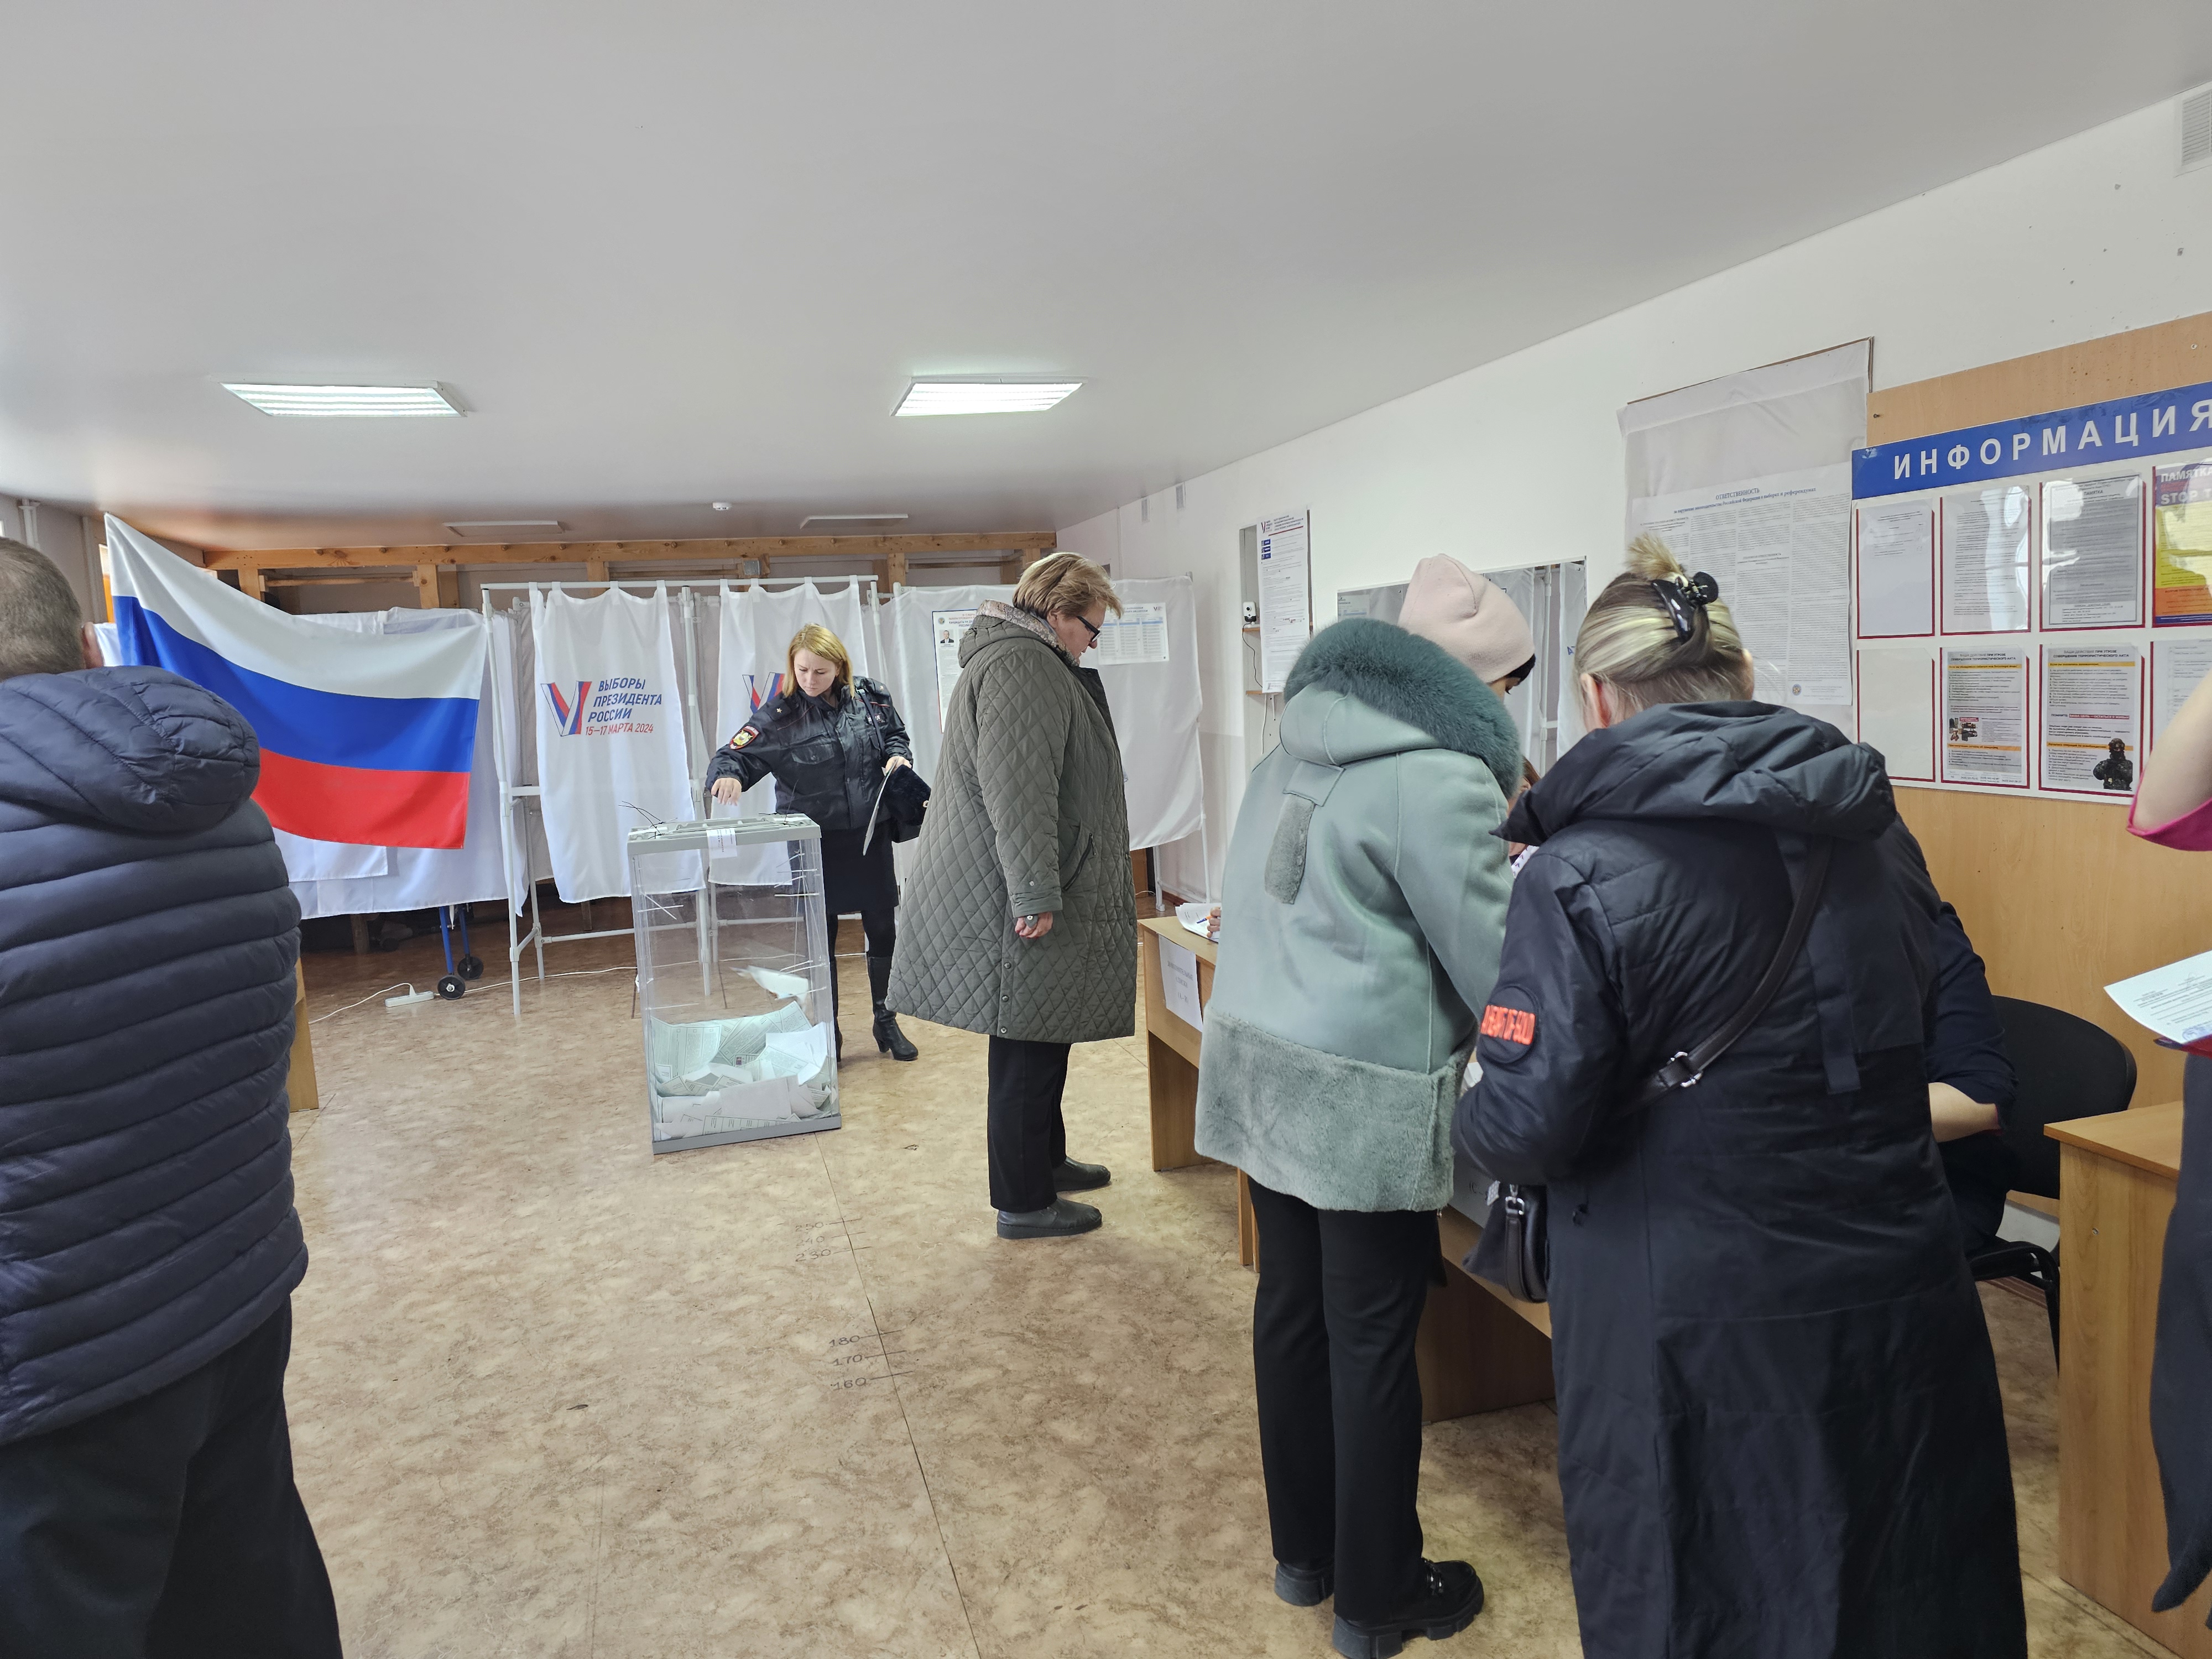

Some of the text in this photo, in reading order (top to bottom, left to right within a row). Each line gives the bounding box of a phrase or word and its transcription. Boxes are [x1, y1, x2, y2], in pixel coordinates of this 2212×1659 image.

[1894, 399, 2212, 479] ИНФОРМАЦИЯ
[1715, 488, 1760, 500] ОТВЕТСТВЕННОСТЬ
[1784, 488, 1816, 497] референдумах
[2161, 490, 2198, 505] STOP
[598, 677, 646, 691] ВЫБОРЫ
[593, 693, 662, 707] ПРЕЗИДЕНТА
[588, 708, 633, 722] РОССИИ
[608, 723, 633, 734] МАРТА
[635, 723, 653, 733] 2024
[795, 1222, 824, 1232] 250
[796, 1236, 825, 1246] 240
[795, 1249, 831, 1262] 230
[829, 1335, 860, 1348] 180
[832, 1354, 863, 1366] 170
[833, 1377, 867, 1391] 160
